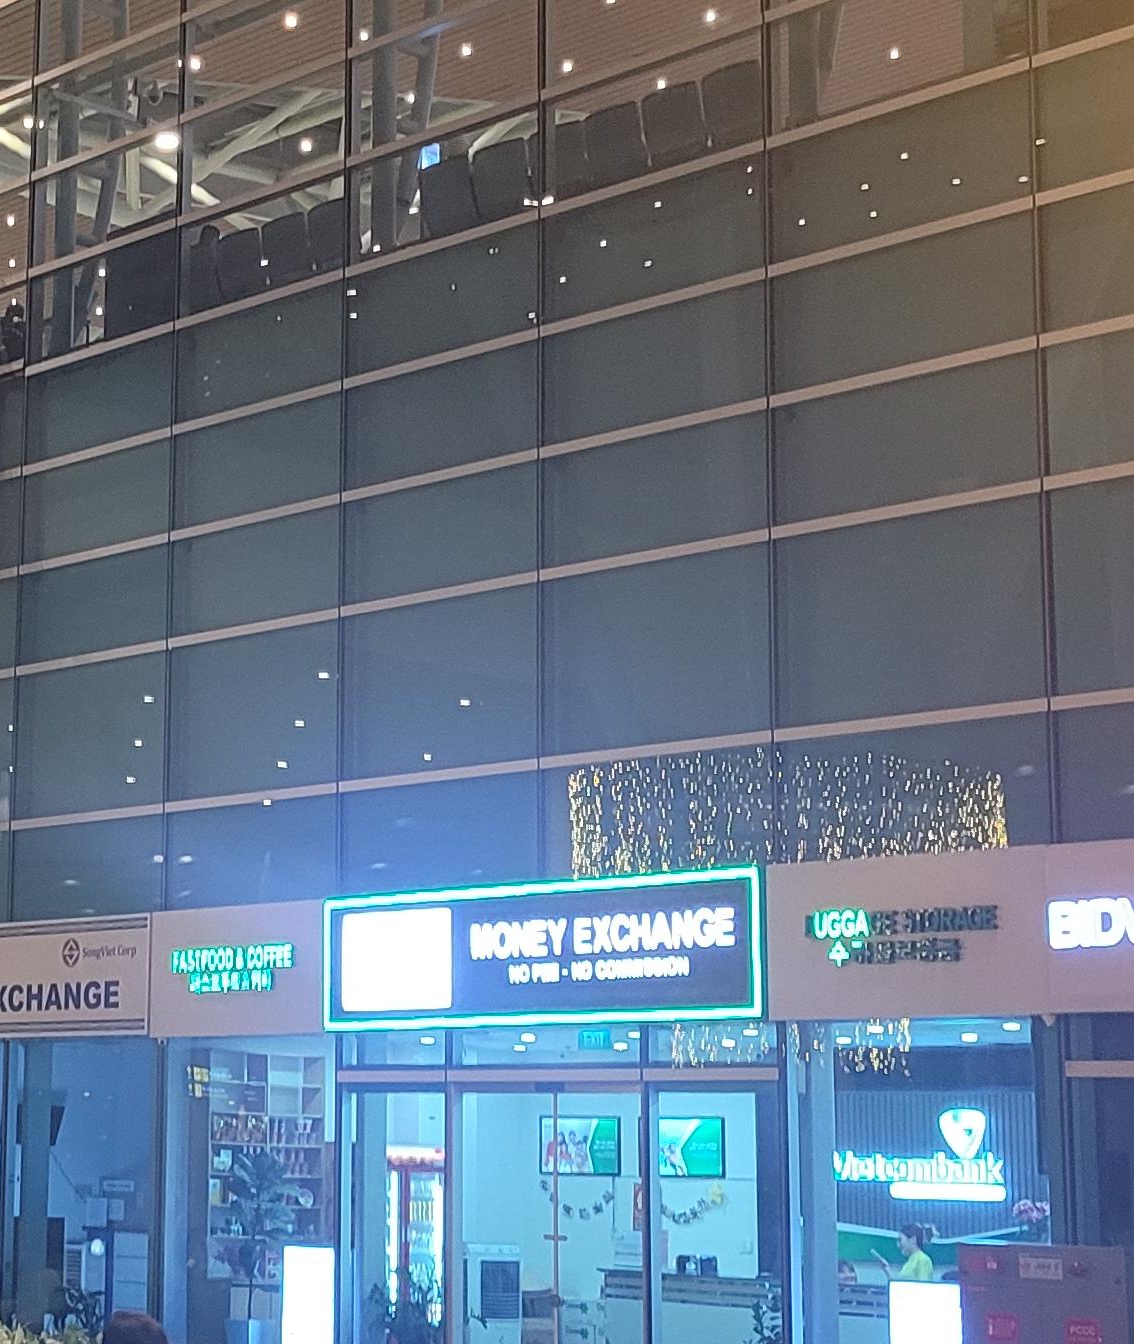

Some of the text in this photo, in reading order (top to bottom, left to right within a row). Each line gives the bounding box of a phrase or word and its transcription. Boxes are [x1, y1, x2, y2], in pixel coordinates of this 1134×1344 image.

[469, 906, 736, 961] MONEY EXCHANGE
[171, 947, 234, 974] FASTFOOD
[246, 942, 294, 970] COFFEE
[507, 962, 531, 985] NO
[570, 959, 593, 982] NO
[833, 1150, 1005, 1184] Vietcombank
